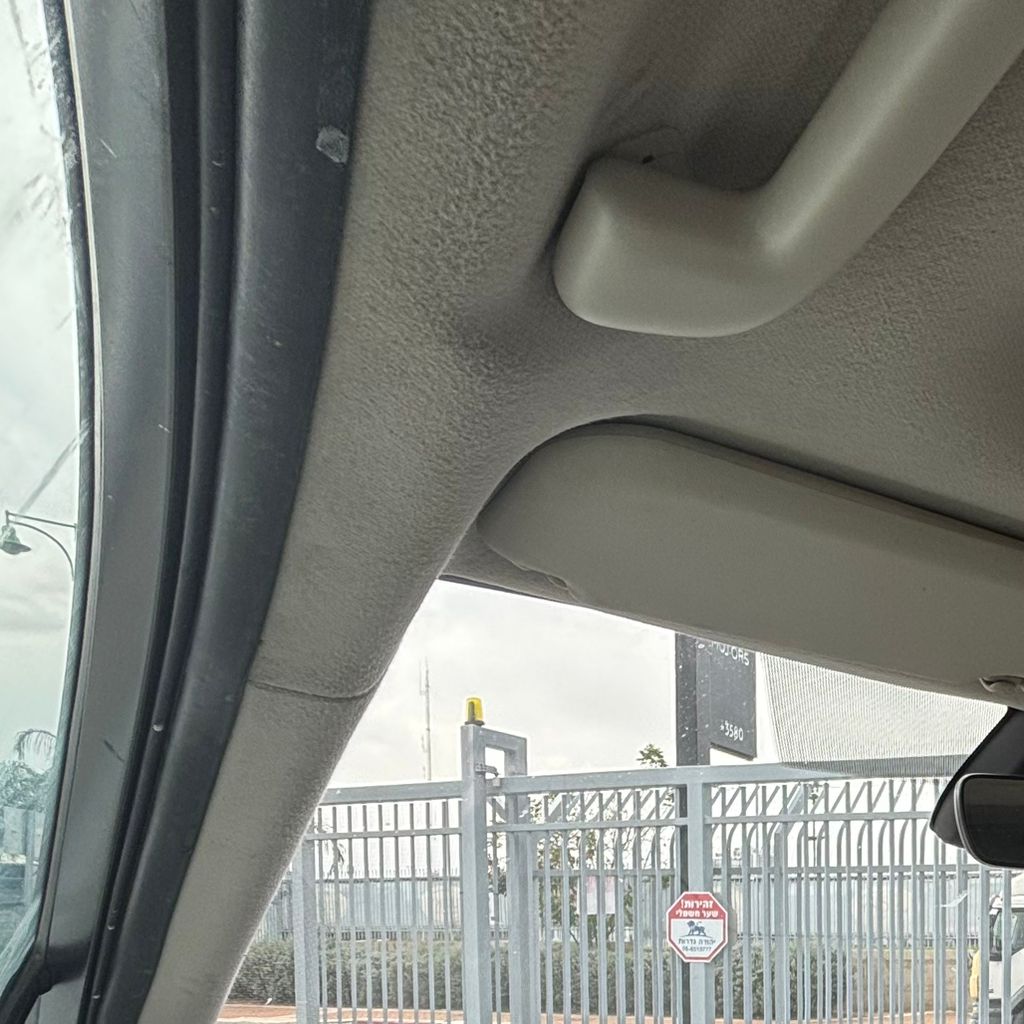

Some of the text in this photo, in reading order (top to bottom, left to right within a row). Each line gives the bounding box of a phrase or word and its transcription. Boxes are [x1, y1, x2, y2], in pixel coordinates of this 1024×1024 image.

[681, 899, 714, 909] זהירות!
[675, 909, 719, 918] שער חשמלי
